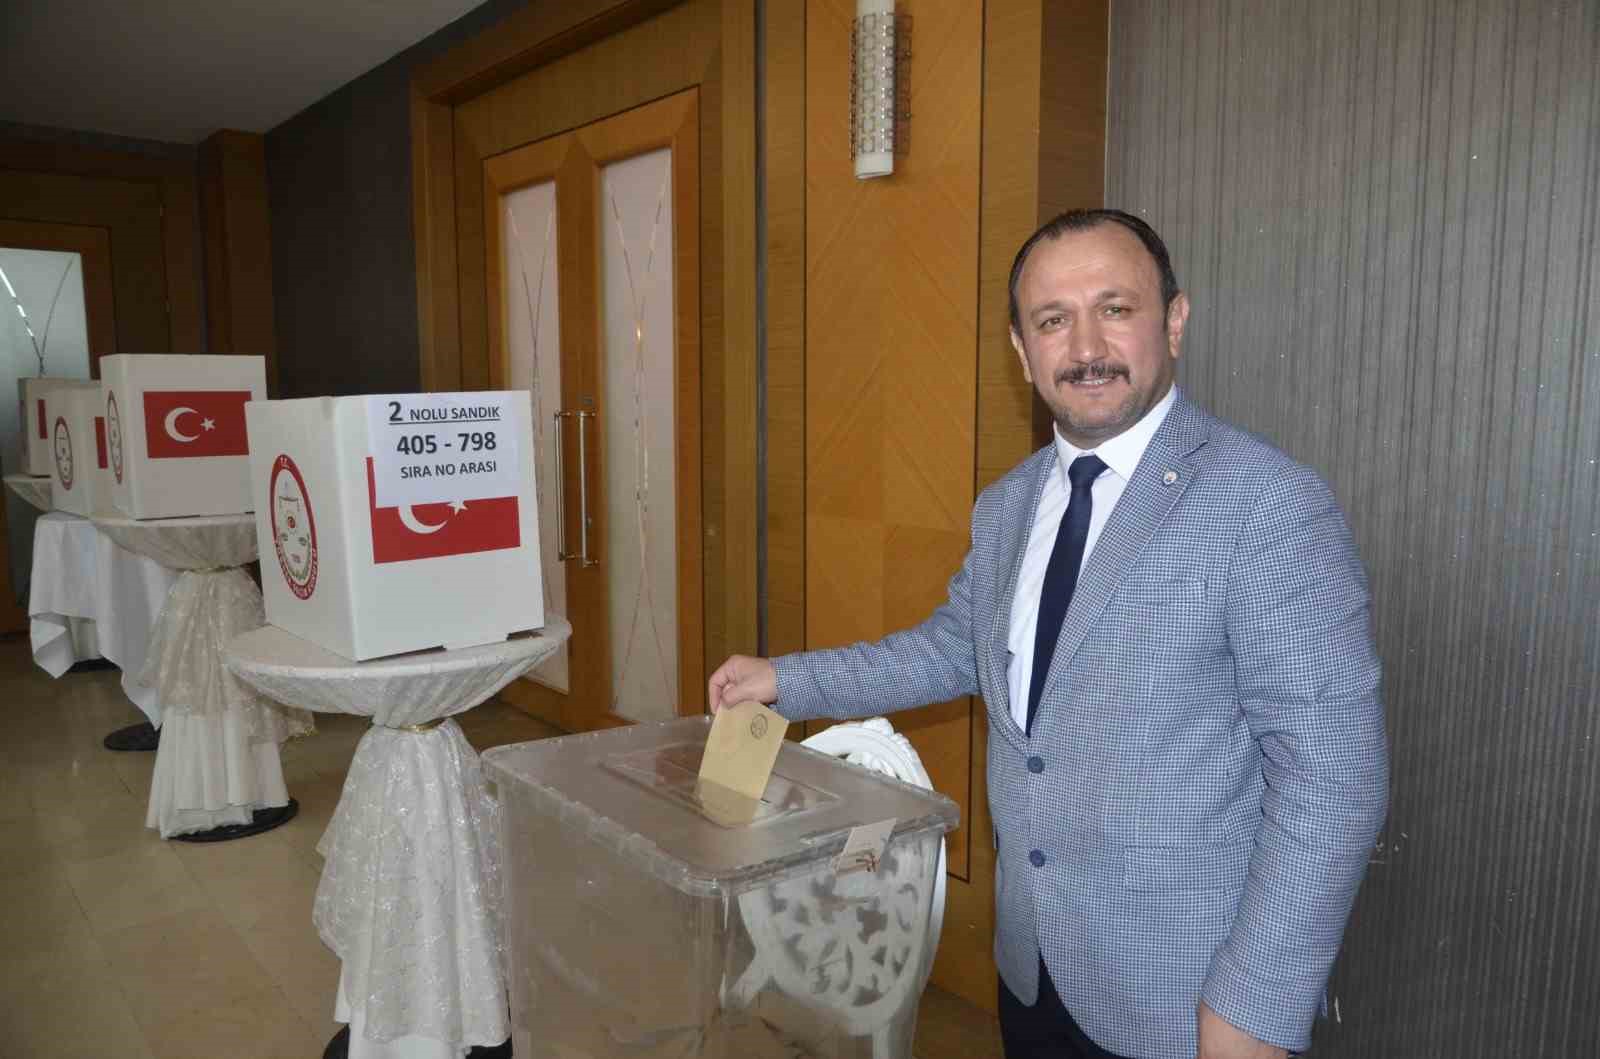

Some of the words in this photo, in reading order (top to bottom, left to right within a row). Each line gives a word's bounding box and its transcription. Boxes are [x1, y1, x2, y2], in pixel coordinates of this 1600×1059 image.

[388, 401, 403, 422] 2
[410, 408, 448, 421] NOLU
[451, 406, 500, 420] SANDIK
[396, 434, 437, 455] 405
[457, 431, 497, 452] 798
[400, 464, 432, 479] SIRA
[435, 463, 456, 476] NO
[459, 460, 497, 475] ARASI
